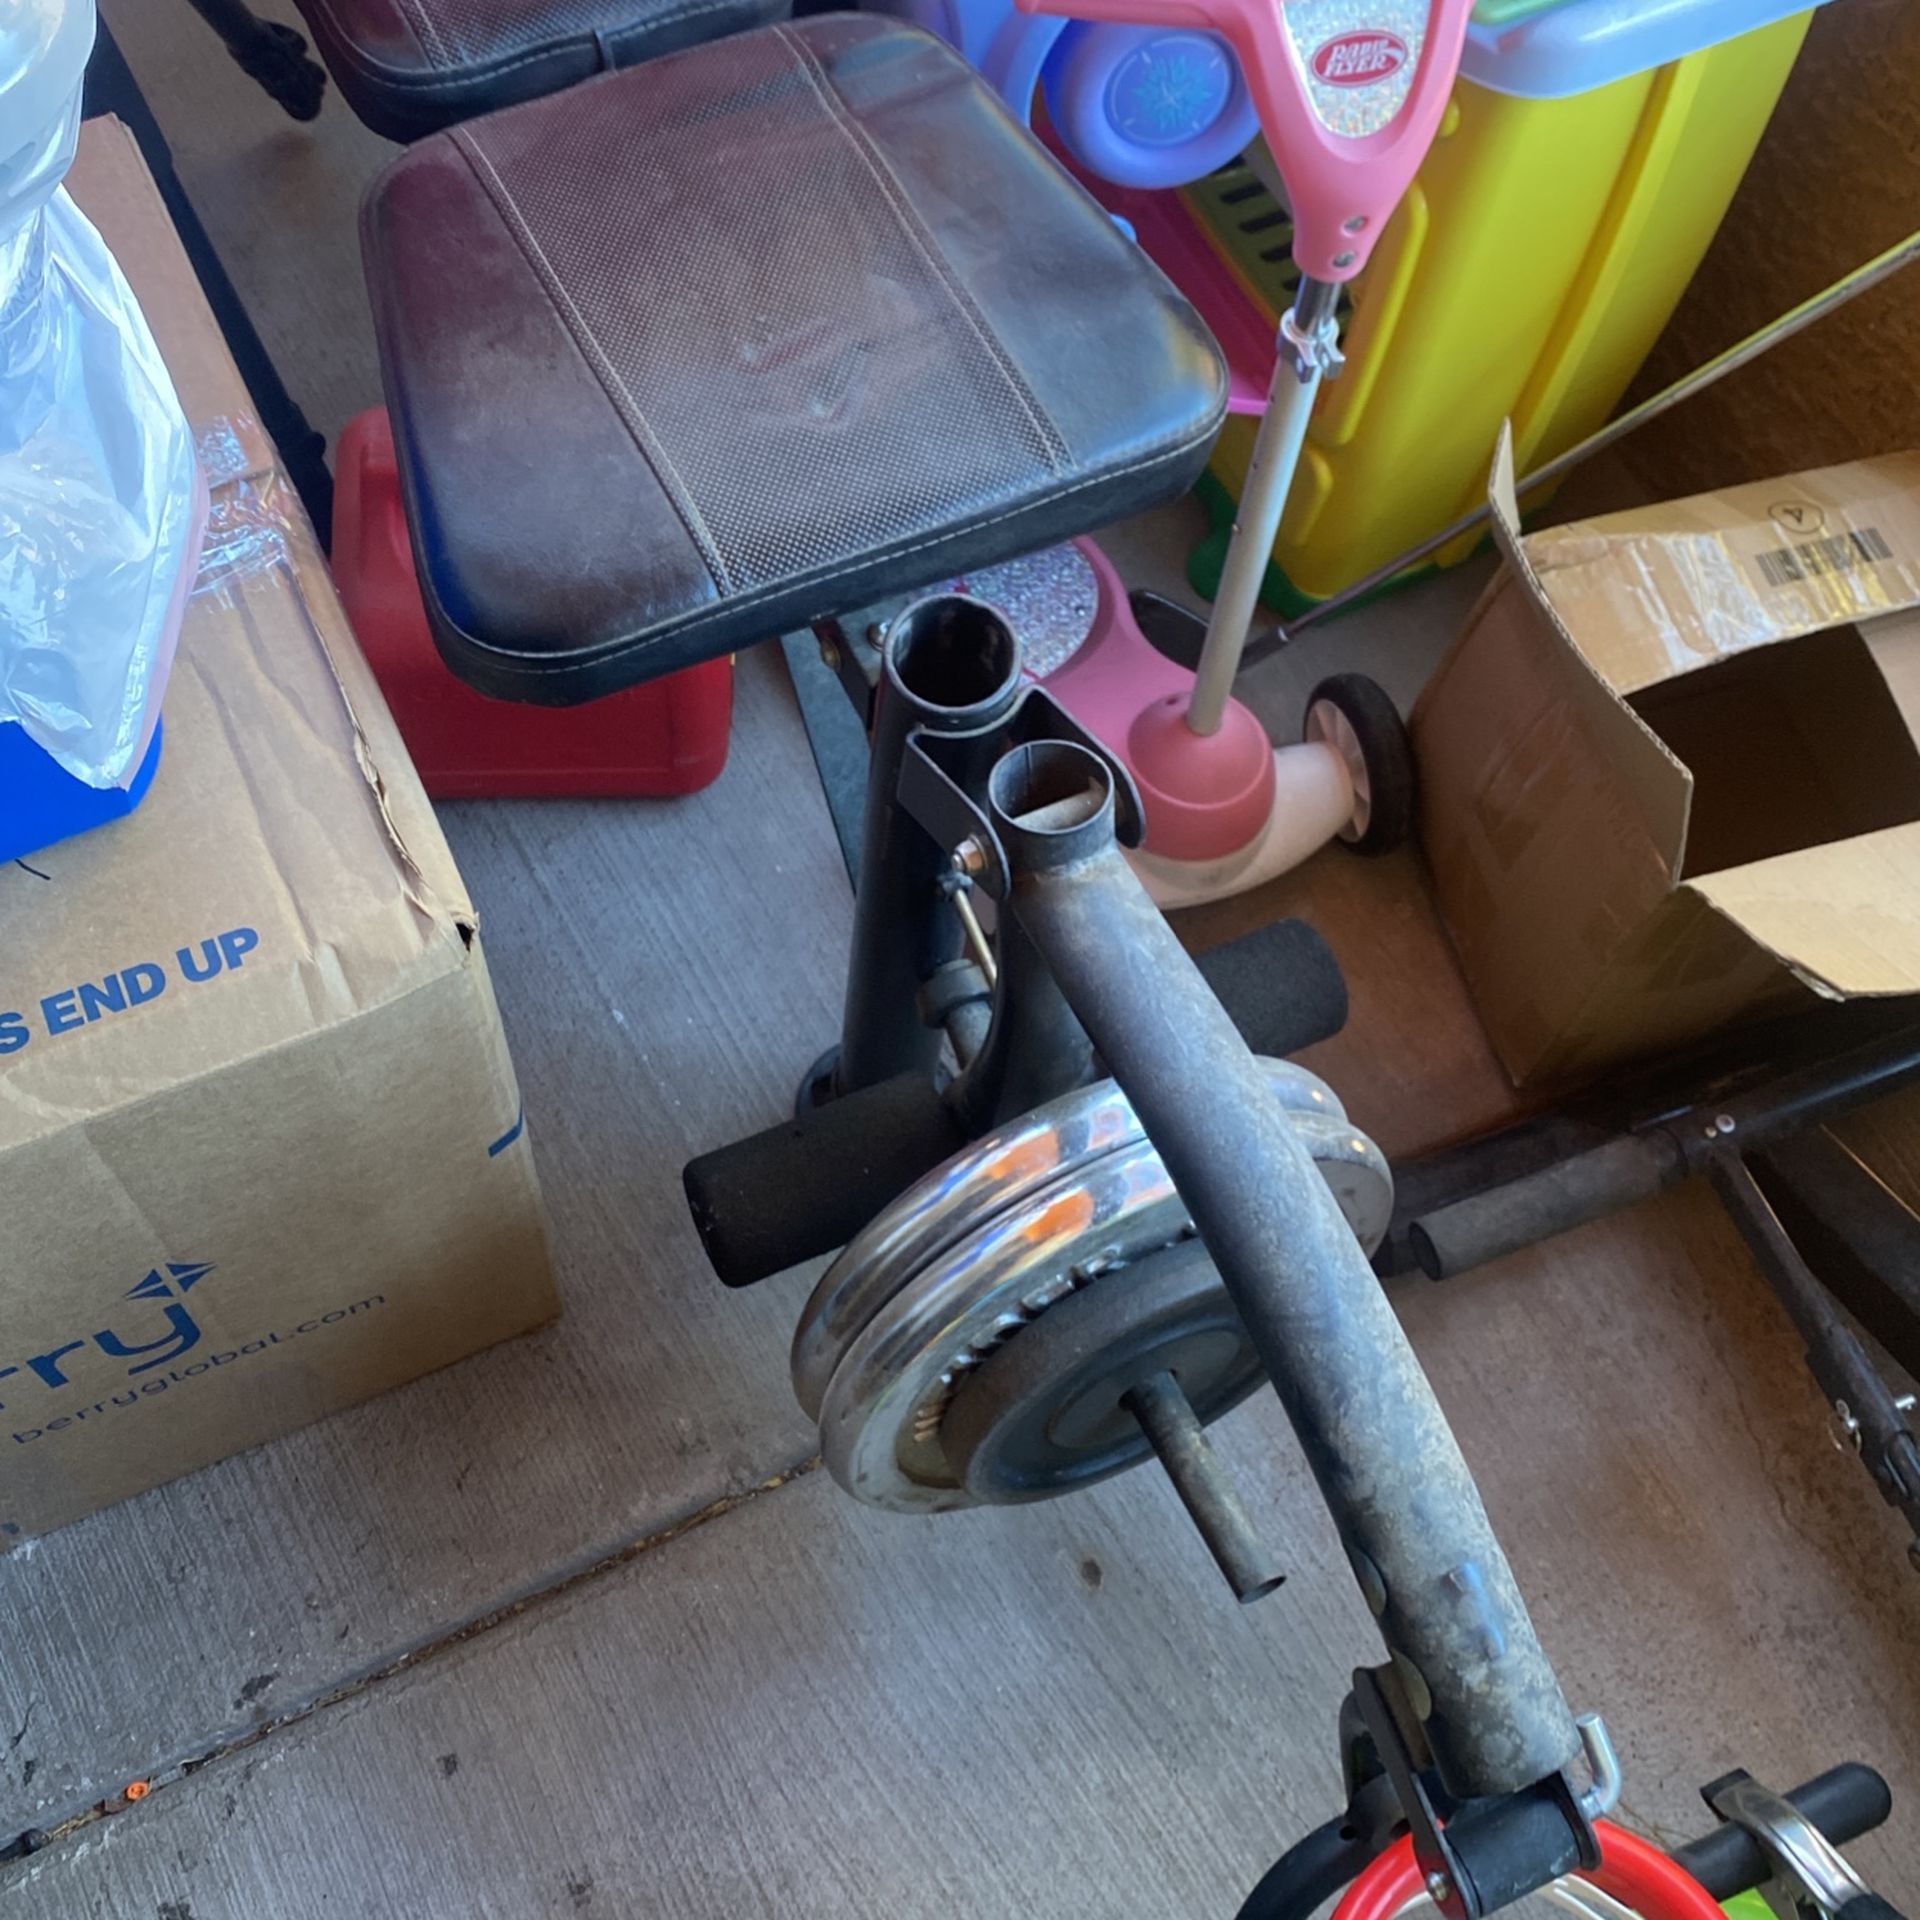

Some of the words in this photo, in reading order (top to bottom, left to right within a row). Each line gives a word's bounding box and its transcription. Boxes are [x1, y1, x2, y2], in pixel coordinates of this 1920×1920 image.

[1323, 55, 1388, 77] FLYER
[40, 962, 166, 1036] END
[175, 927, 259, 982] UP
[12, 1295, 386, 1444] berryglobal.com
